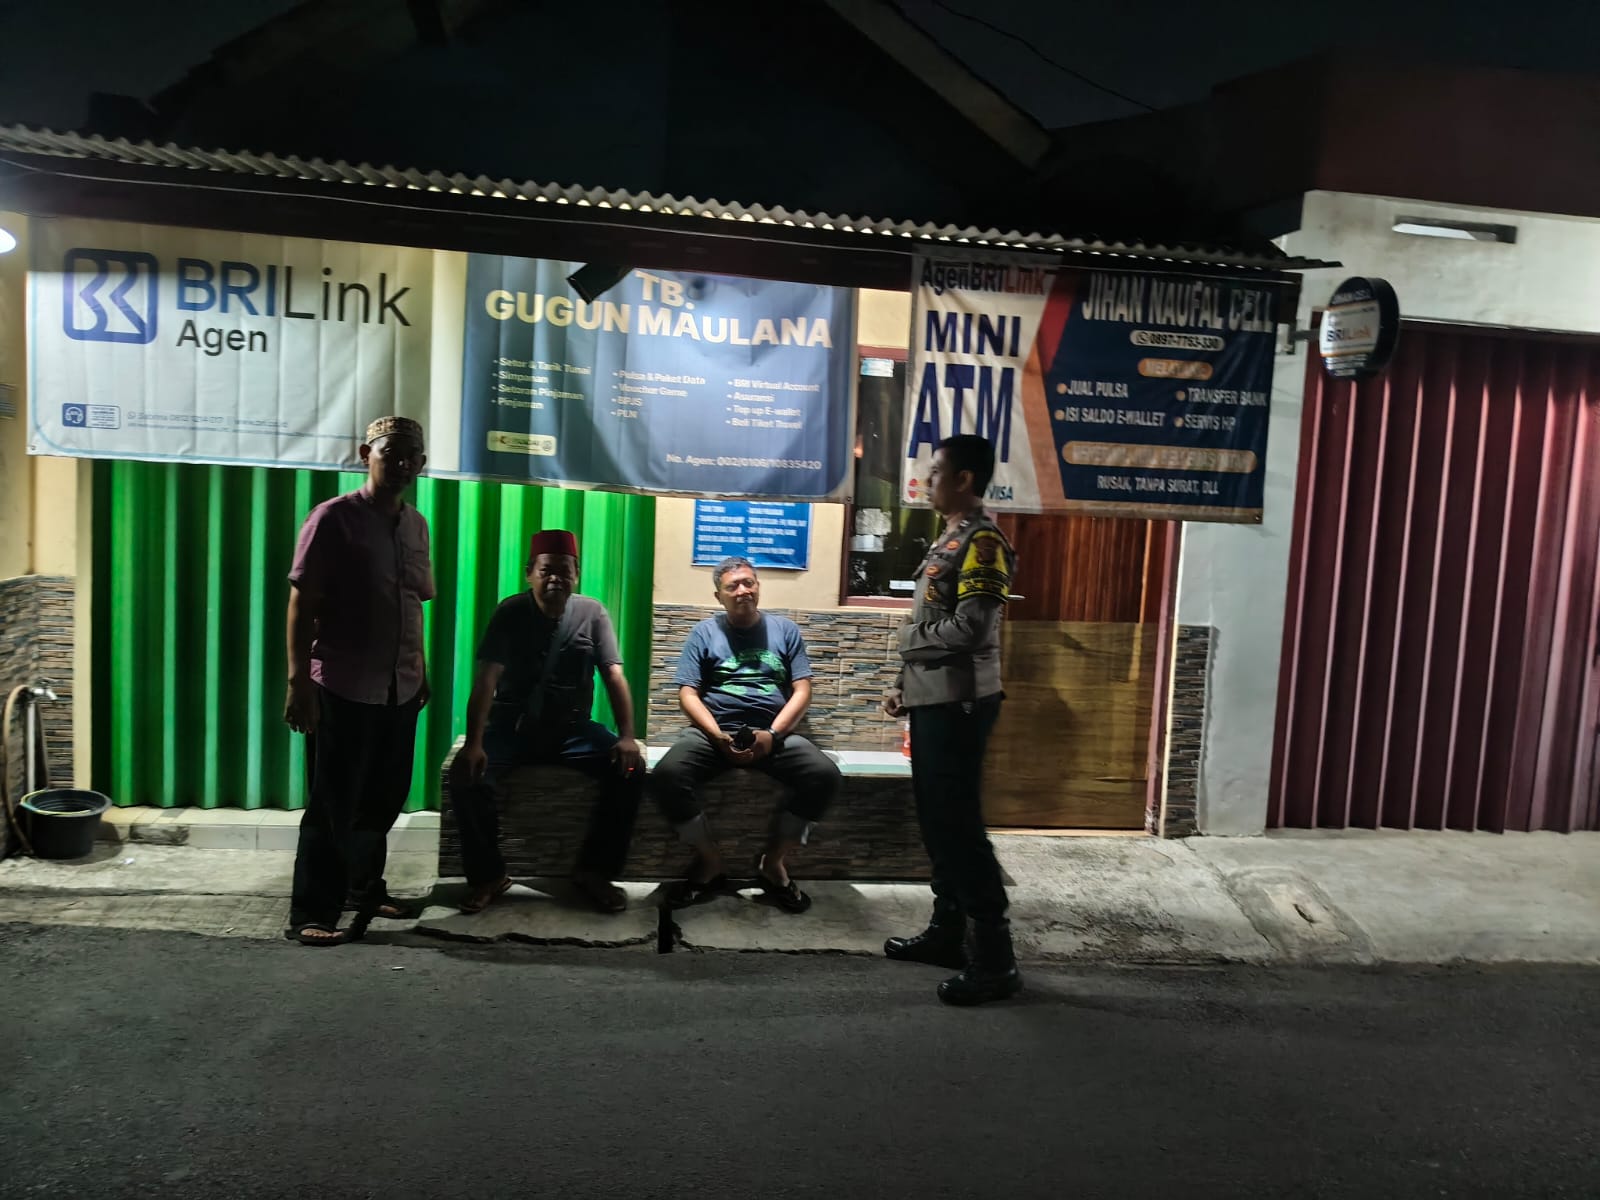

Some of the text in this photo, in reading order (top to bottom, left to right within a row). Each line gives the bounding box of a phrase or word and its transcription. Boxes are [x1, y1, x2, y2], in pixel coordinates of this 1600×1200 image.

[176, 258, 411, 326] BRILink
[635, 270, 694, 309] TB.
[1082, 272, 1273, 333] JIHAN NAUFAL CELL
[485, 290, 832, 348] GUGUN MAULANA
[925, 310, 1021, 357] MINI
[176, 319, 267, 356] Agen
[659, 386, 688, 397] Game
[683, 375, 706, 385] Data
[1067, 380, 1129, 398] JUAL PULSA
[1188, 387, 1267, 406] TRANSFER BANK
[908, 362, 1014, 463] ATM
[1066, 406, 1166, 427] ISI SALDO E-WALLET
[1184, 414, 1220, 430] SERVIS
[1135, 477, 1165, 492] TANPA
